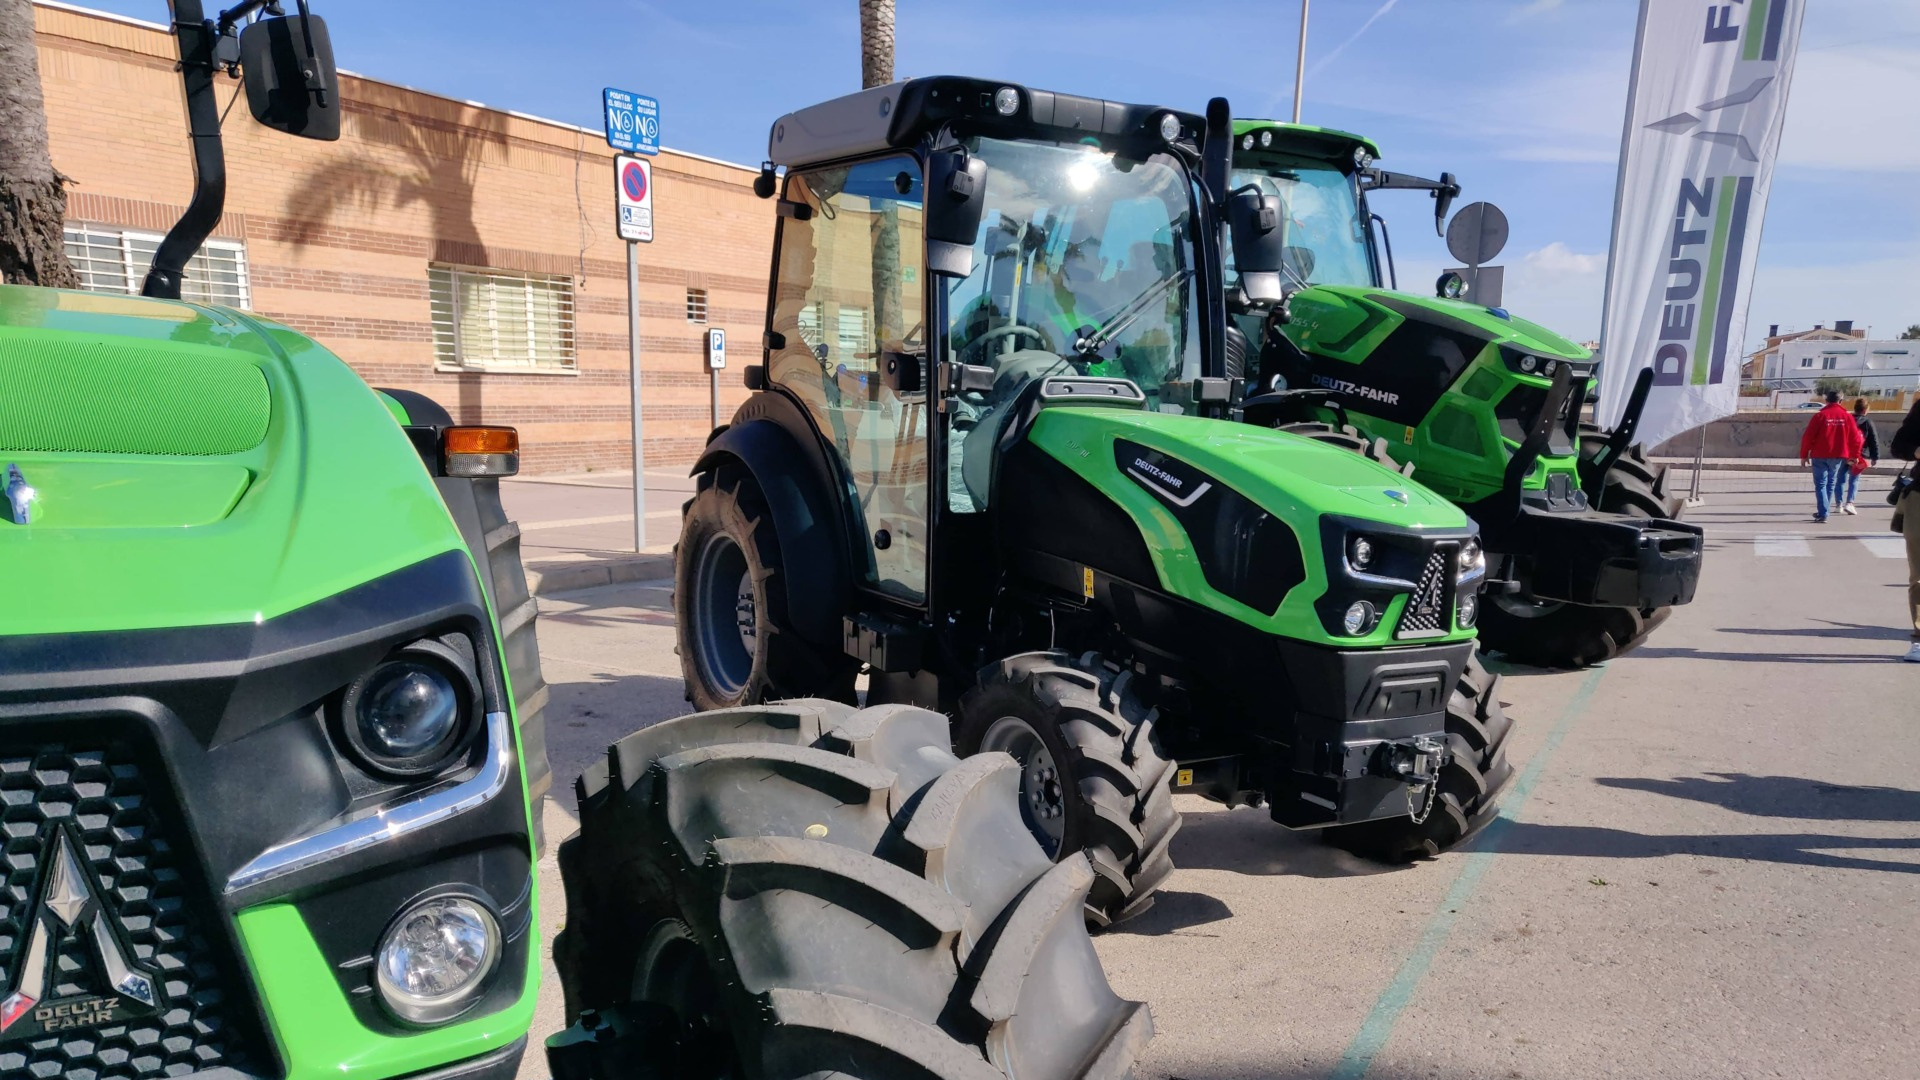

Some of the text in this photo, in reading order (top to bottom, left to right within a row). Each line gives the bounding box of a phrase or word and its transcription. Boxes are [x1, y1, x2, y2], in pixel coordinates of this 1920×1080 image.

[1702, 0, 1744, 44] F
[1653, 177, 1714, 387] DEUTZ
[1311, 374, 1399, 405] DEUTZ-FAHR
[1134, 458, 1183, 489] DEUTZ-FAHR
[35, 997, 119, 1021] DEUTZ
[44, 1010, 113, 1032] FAHR
